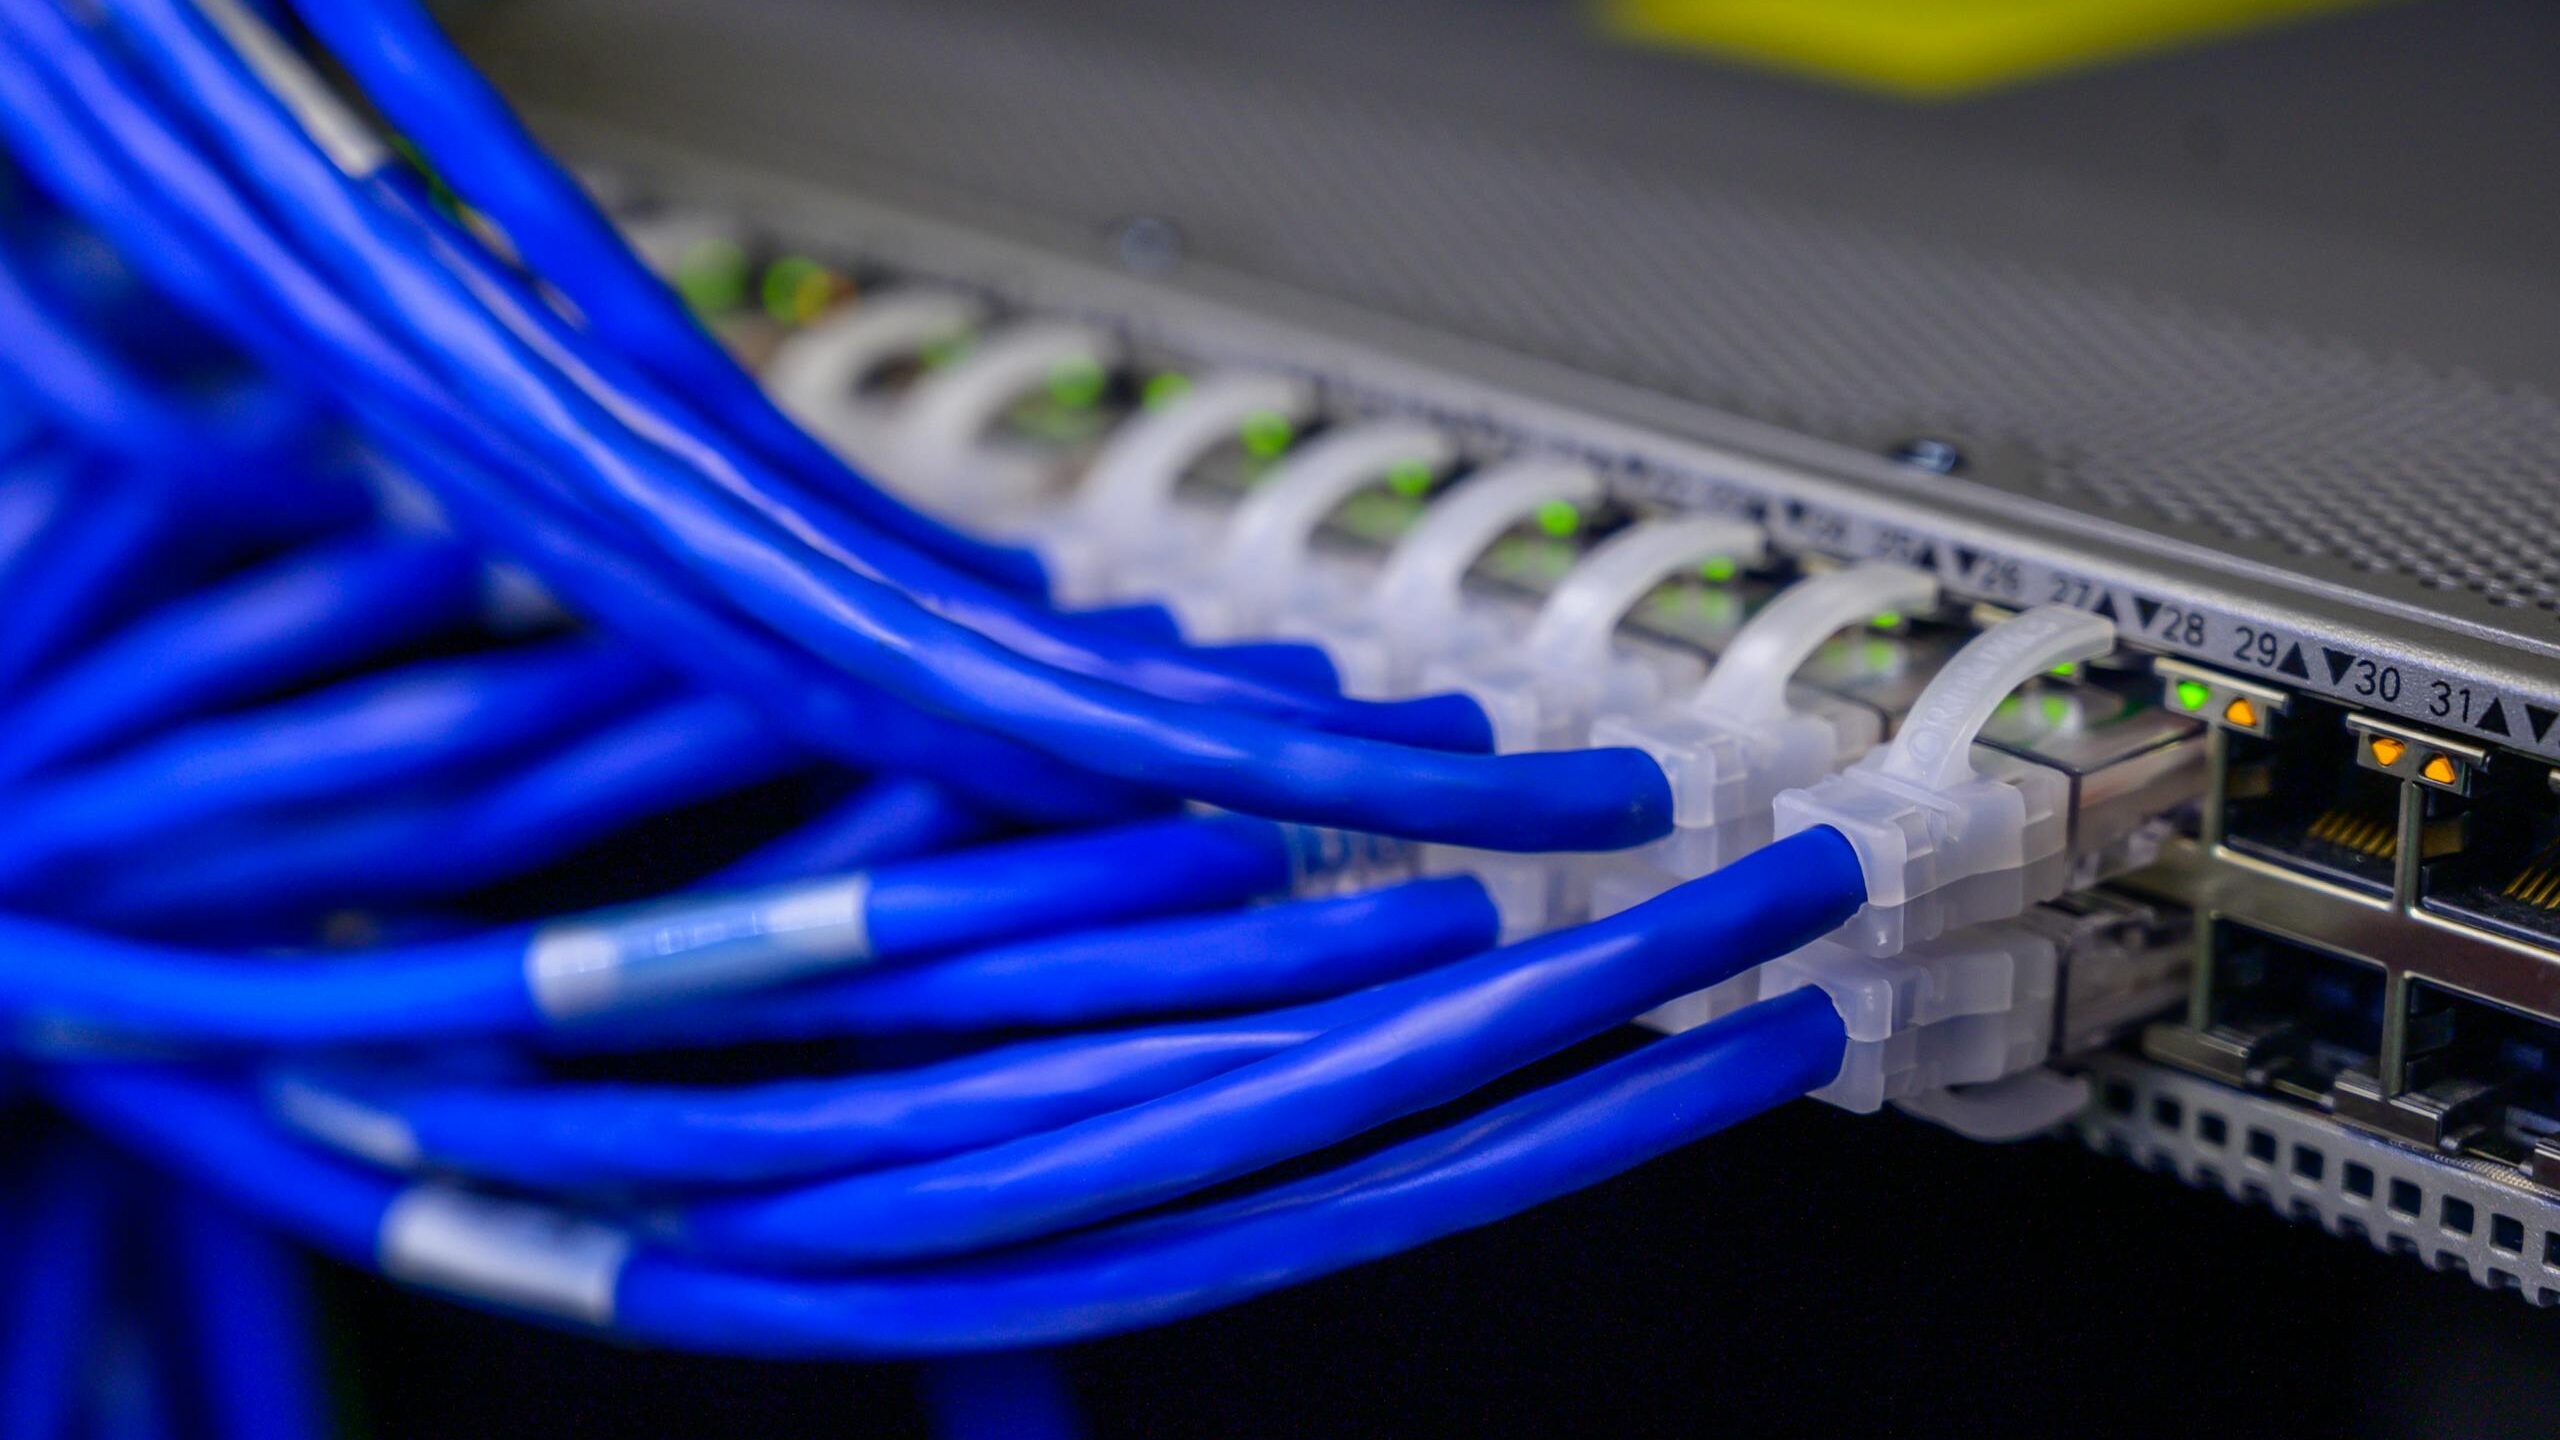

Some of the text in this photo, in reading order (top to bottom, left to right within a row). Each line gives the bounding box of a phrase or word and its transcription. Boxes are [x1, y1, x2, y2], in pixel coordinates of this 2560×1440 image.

[2051, 577, 2091, 608] 27
[2162, 605, 2205, 647] 28
[2233, 624, 2278, 668] 29
[2354, 659, 2401, 702] 30
[2429, 680, 2471, 723] 31
